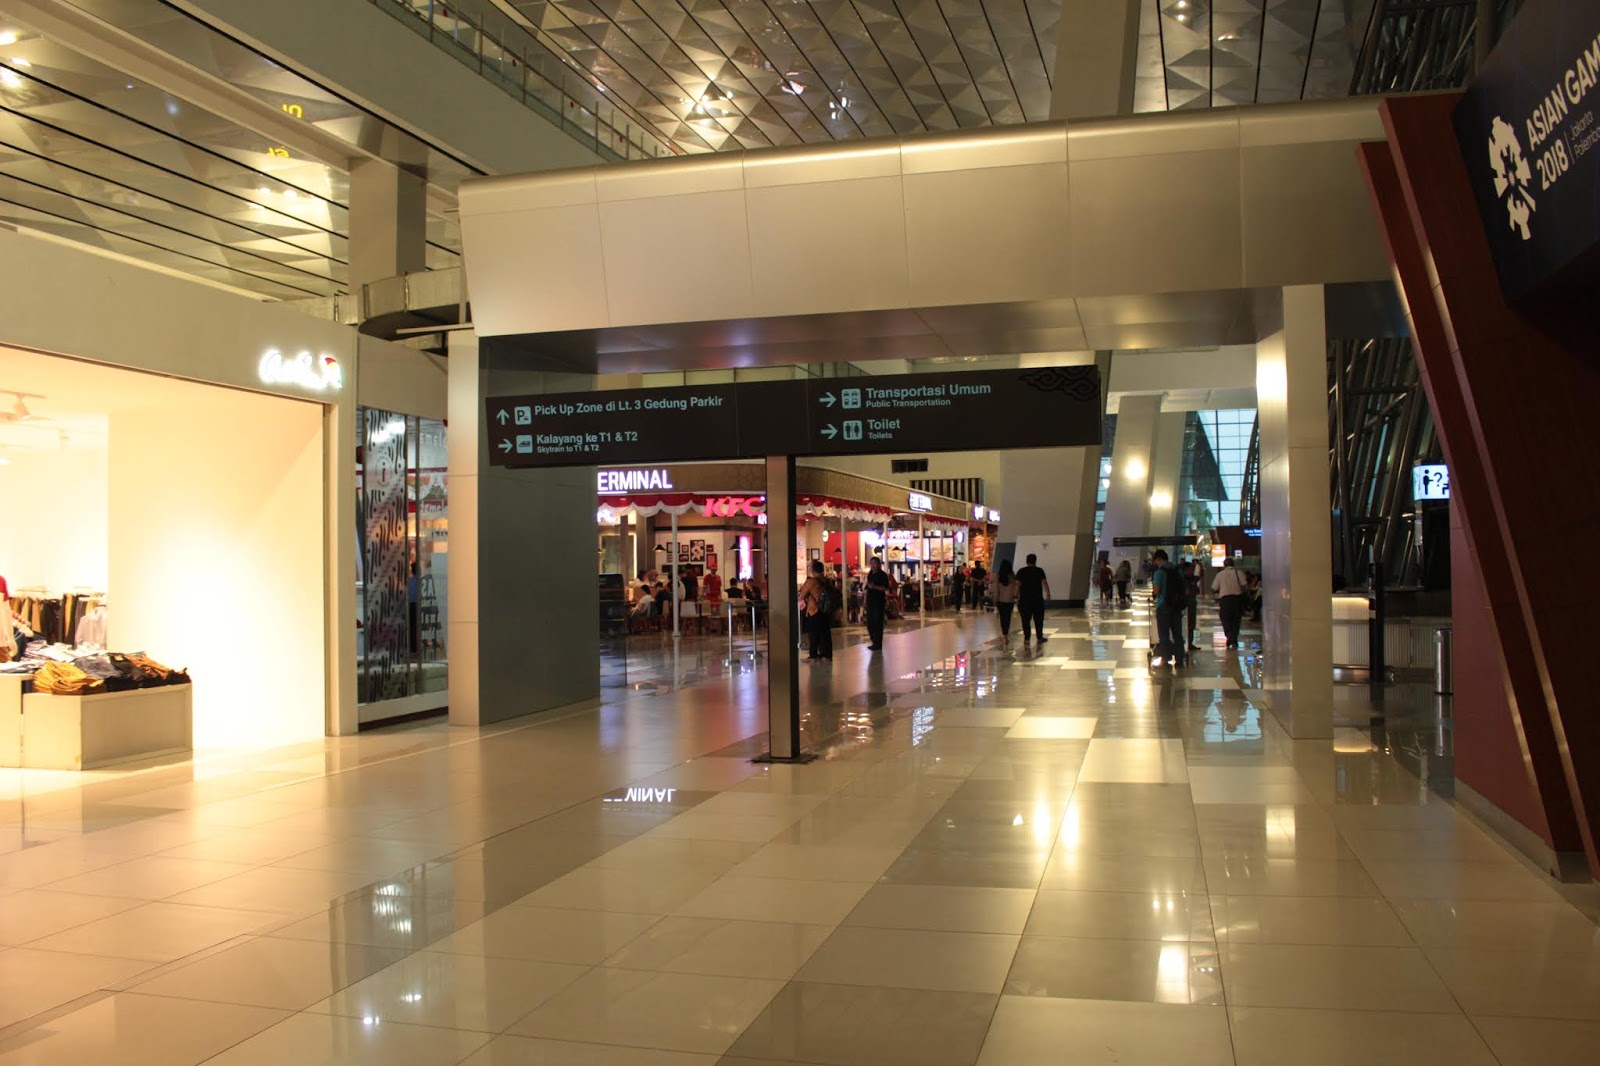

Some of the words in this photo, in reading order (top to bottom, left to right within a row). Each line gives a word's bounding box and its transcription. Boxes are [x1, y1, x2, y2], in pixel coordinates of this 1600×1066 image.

[1526, 83, 1568, 152] ASIAN
[1565, 32, 1600, 105] GAM
[1536, 139, 1569, 191] 2018
[866, 385, 946, 400] Transportasi
[949, 383, 991, 396] Umum
[534, 405, 557, 415] Pick
[560, 404, 574, 416] Up
[576, 403, 603, 413] Zone
[605, 401, 616, 412] di
[618, 400, 632, 411] Lt.
[634, 400, 641, 410] 3
[644, 398, 688, 411] Gedung
[690, 396, 723, 407] Parkir
[866, 399, 891, 408] Public
[892, 398, 951, 408] Transportation
[867, 418, 901, 430] Toilet
[536, 434, 583, 446] Kalayang
[585, 433, 598, 442] ke
[598, 432, 611, 442] T1
[614, 432, 623, 442] &
[624, 431, 638, 441] T2
[868, 432, 893, 440] Toilets
[537, 446, 565, 454] Skytrain
[597, 469, 673, 491] ERMINAL
[702, 496, 764, 517] KFC
